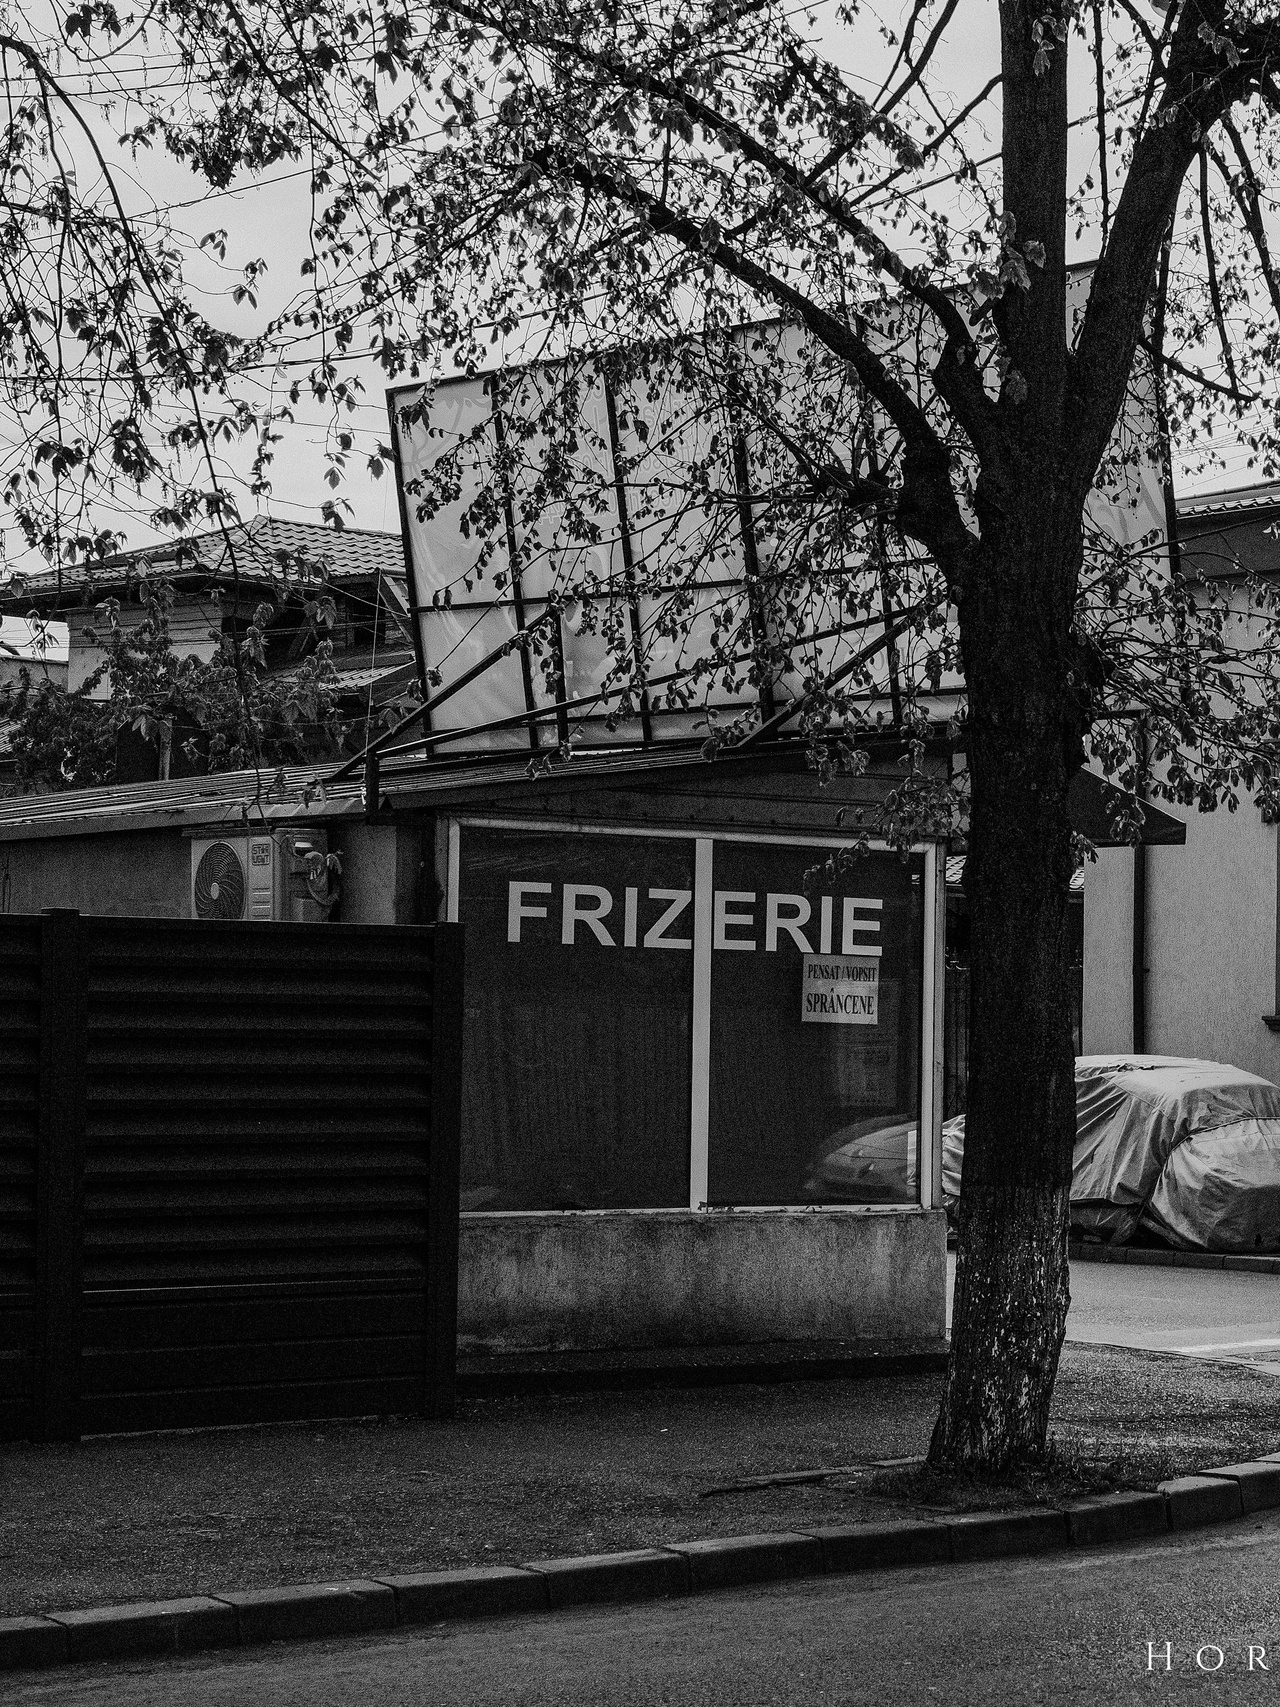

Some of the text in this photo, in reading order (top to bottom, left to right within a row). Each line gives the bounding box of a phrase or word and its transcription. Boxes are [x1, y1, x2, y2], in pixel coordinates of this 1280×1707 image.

[507, 880, 884, 957] FRIZERIE
[807, 964, 840, 980] PENSAT
[846, 966, 877, 982] VOPSIT
[806, 987, 875, 1015] SPRÂNCENE
